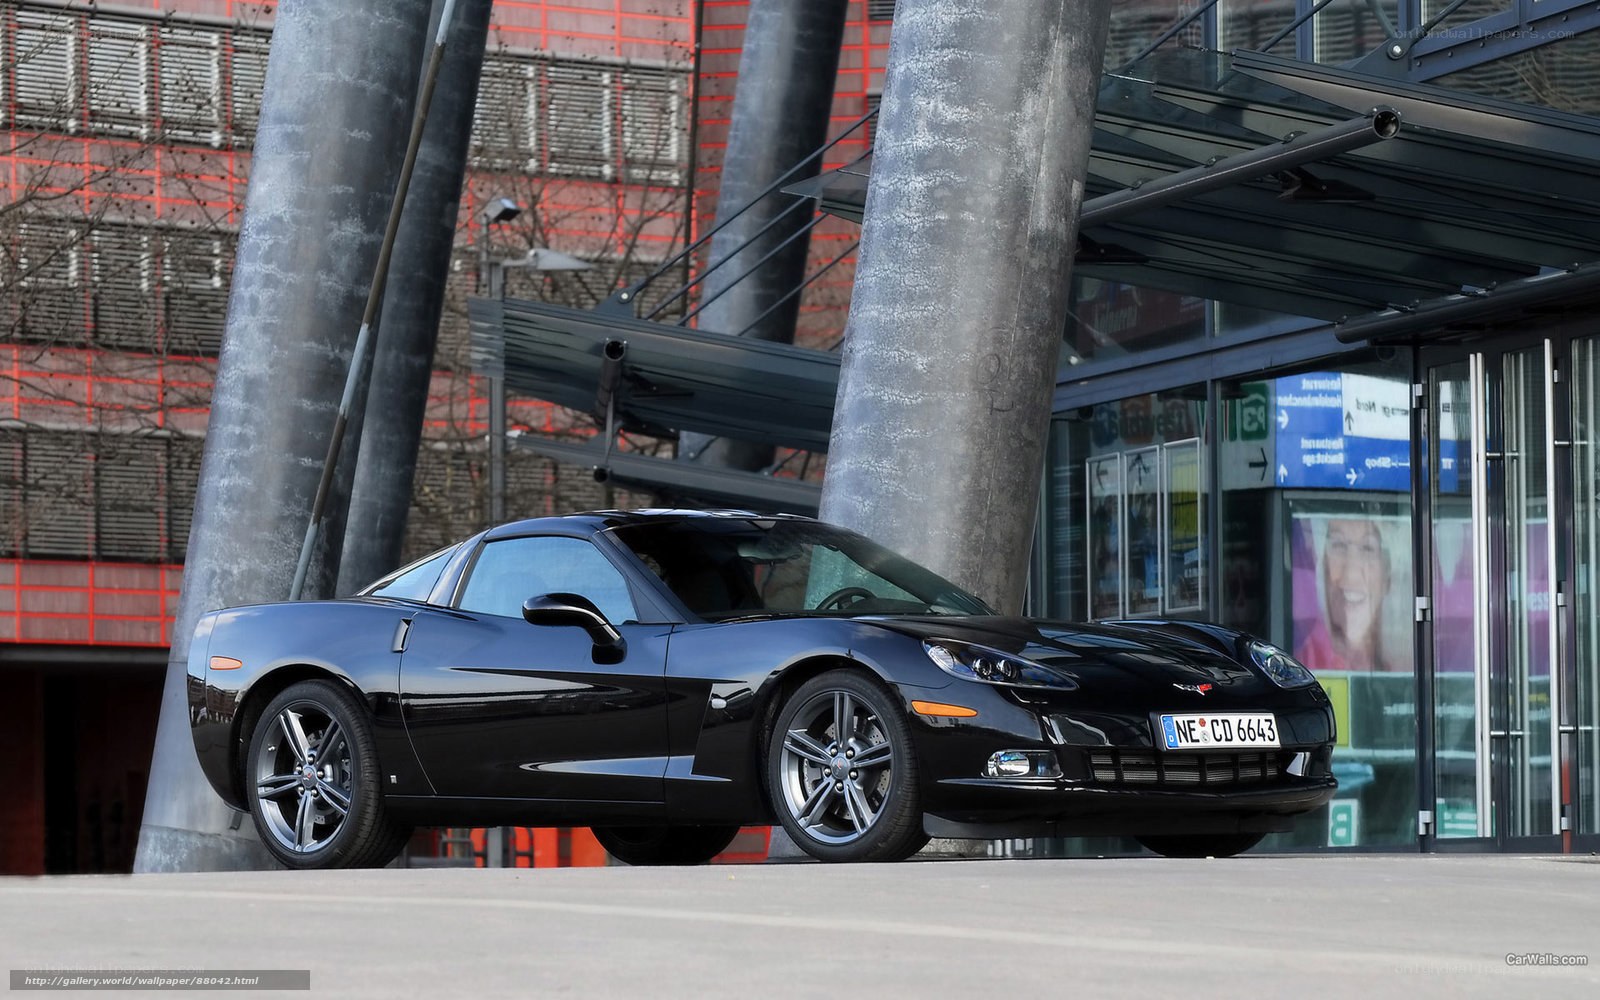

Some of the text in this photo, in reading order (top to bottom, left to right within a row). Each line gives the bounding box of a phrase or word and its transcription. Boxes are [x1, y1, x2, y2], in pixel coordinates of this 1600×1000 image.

[1175, 719, 1276, 743] NE CD 6643
